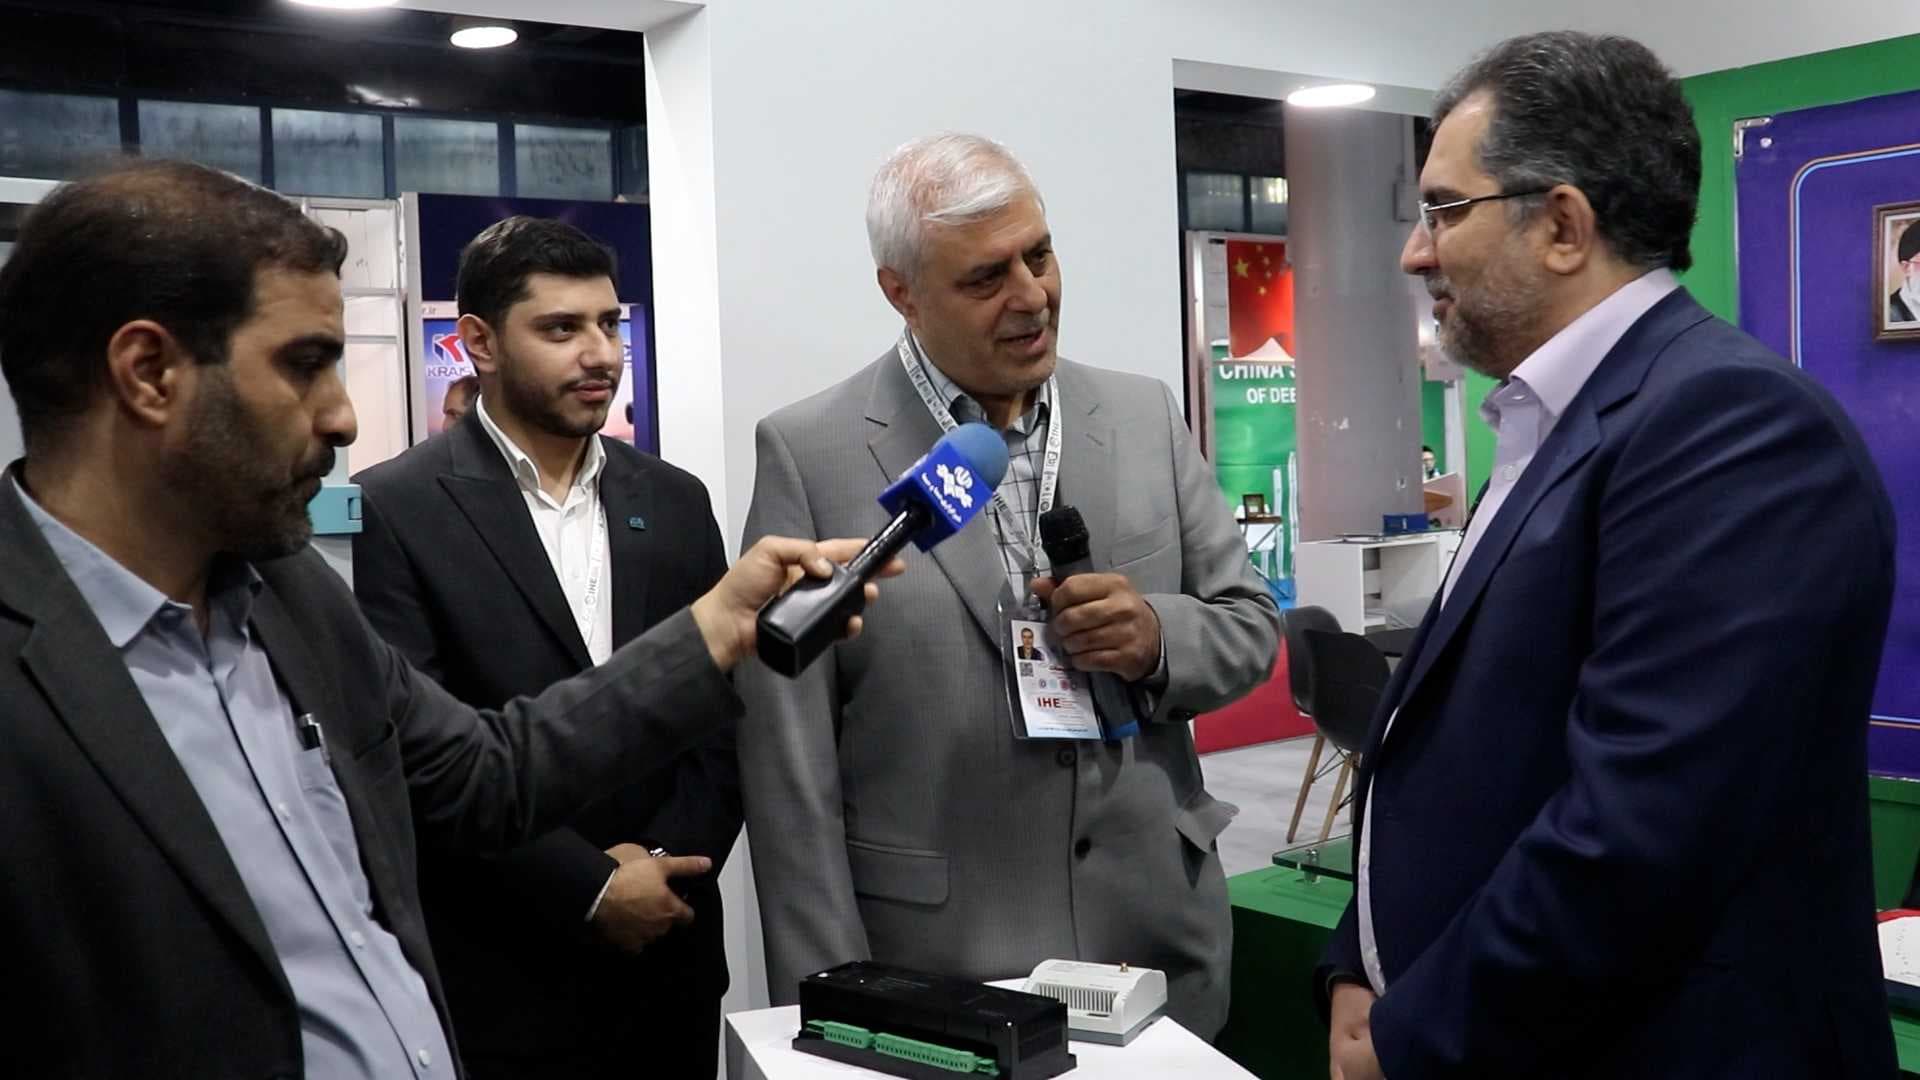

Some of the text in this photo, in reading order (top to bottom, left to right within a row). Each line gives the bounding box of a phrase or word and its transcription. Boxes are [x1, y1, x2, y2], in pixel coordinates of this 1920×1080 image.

[1218, 360, 1285, 380] CHINA
[1246, 387, 1267, 404] OF
[1037, 697, 1062, 709] IHE
